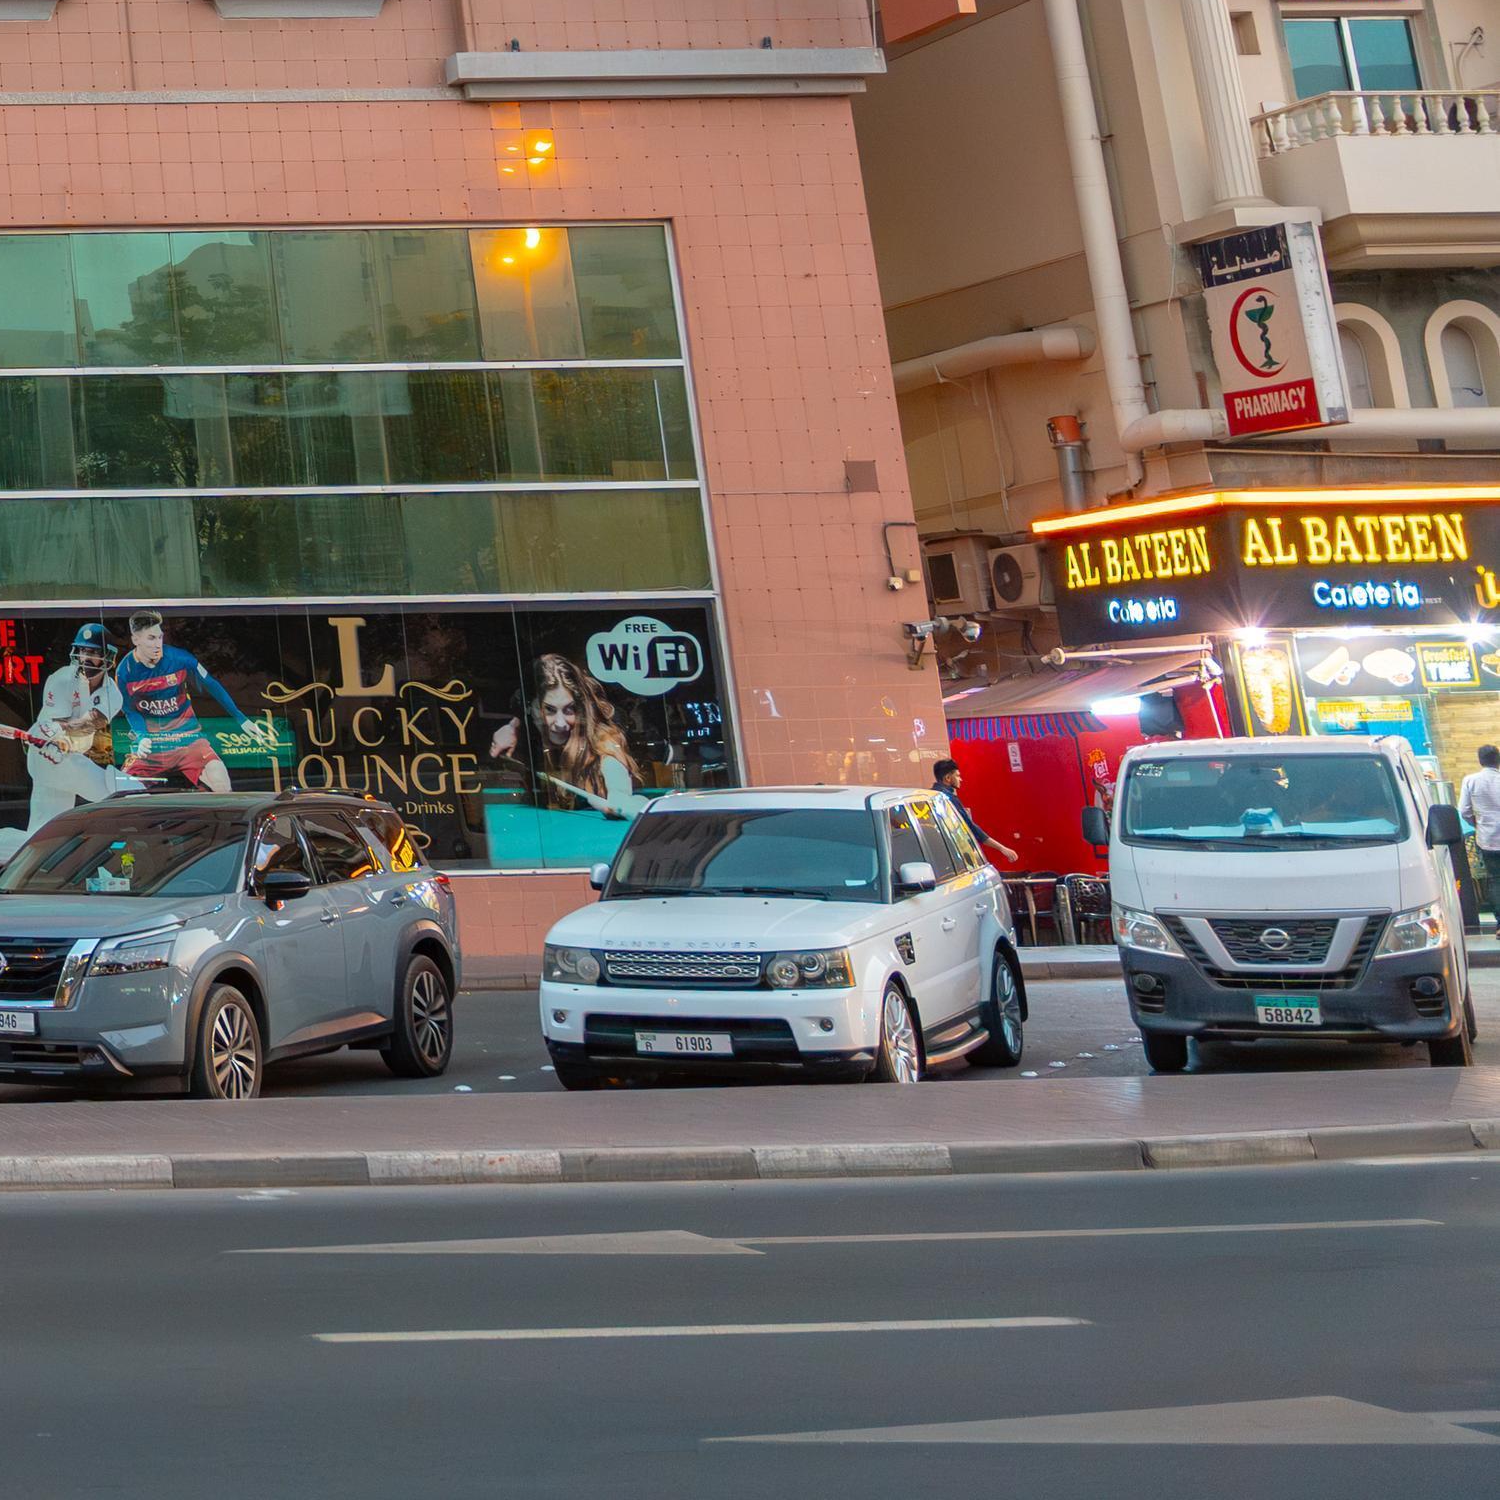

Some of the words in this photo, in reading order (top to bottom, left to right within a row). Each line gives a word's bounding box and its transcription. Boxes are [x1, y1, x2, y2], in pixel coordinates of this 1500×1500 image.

[1234, 385, 1307, 419] PHARMACY
[1243, 516, 1298, 566] AL
[1299, 513, 1469, 564] BATEEN
[1067, 542, 1101, 589] AL
[1101, 526, 1211, 584] BATEEN
[1109, 596, 1177, 624] Cafeeria
[624, 623, 658, 633] FREE
[328, 617, 396, 697] L
[138, 697, 178, 710] QATAR
[149, 705, 179, 716] AIRWAYS
[261, 706, 474, 747] LUCKY
[267, 753, 483, 795] LOUNGE
[405, 801, 455, 815] Drinks
[1264, 1008, 1314, 1023] 58842
[675, 1036, 713, 1051] 61903
